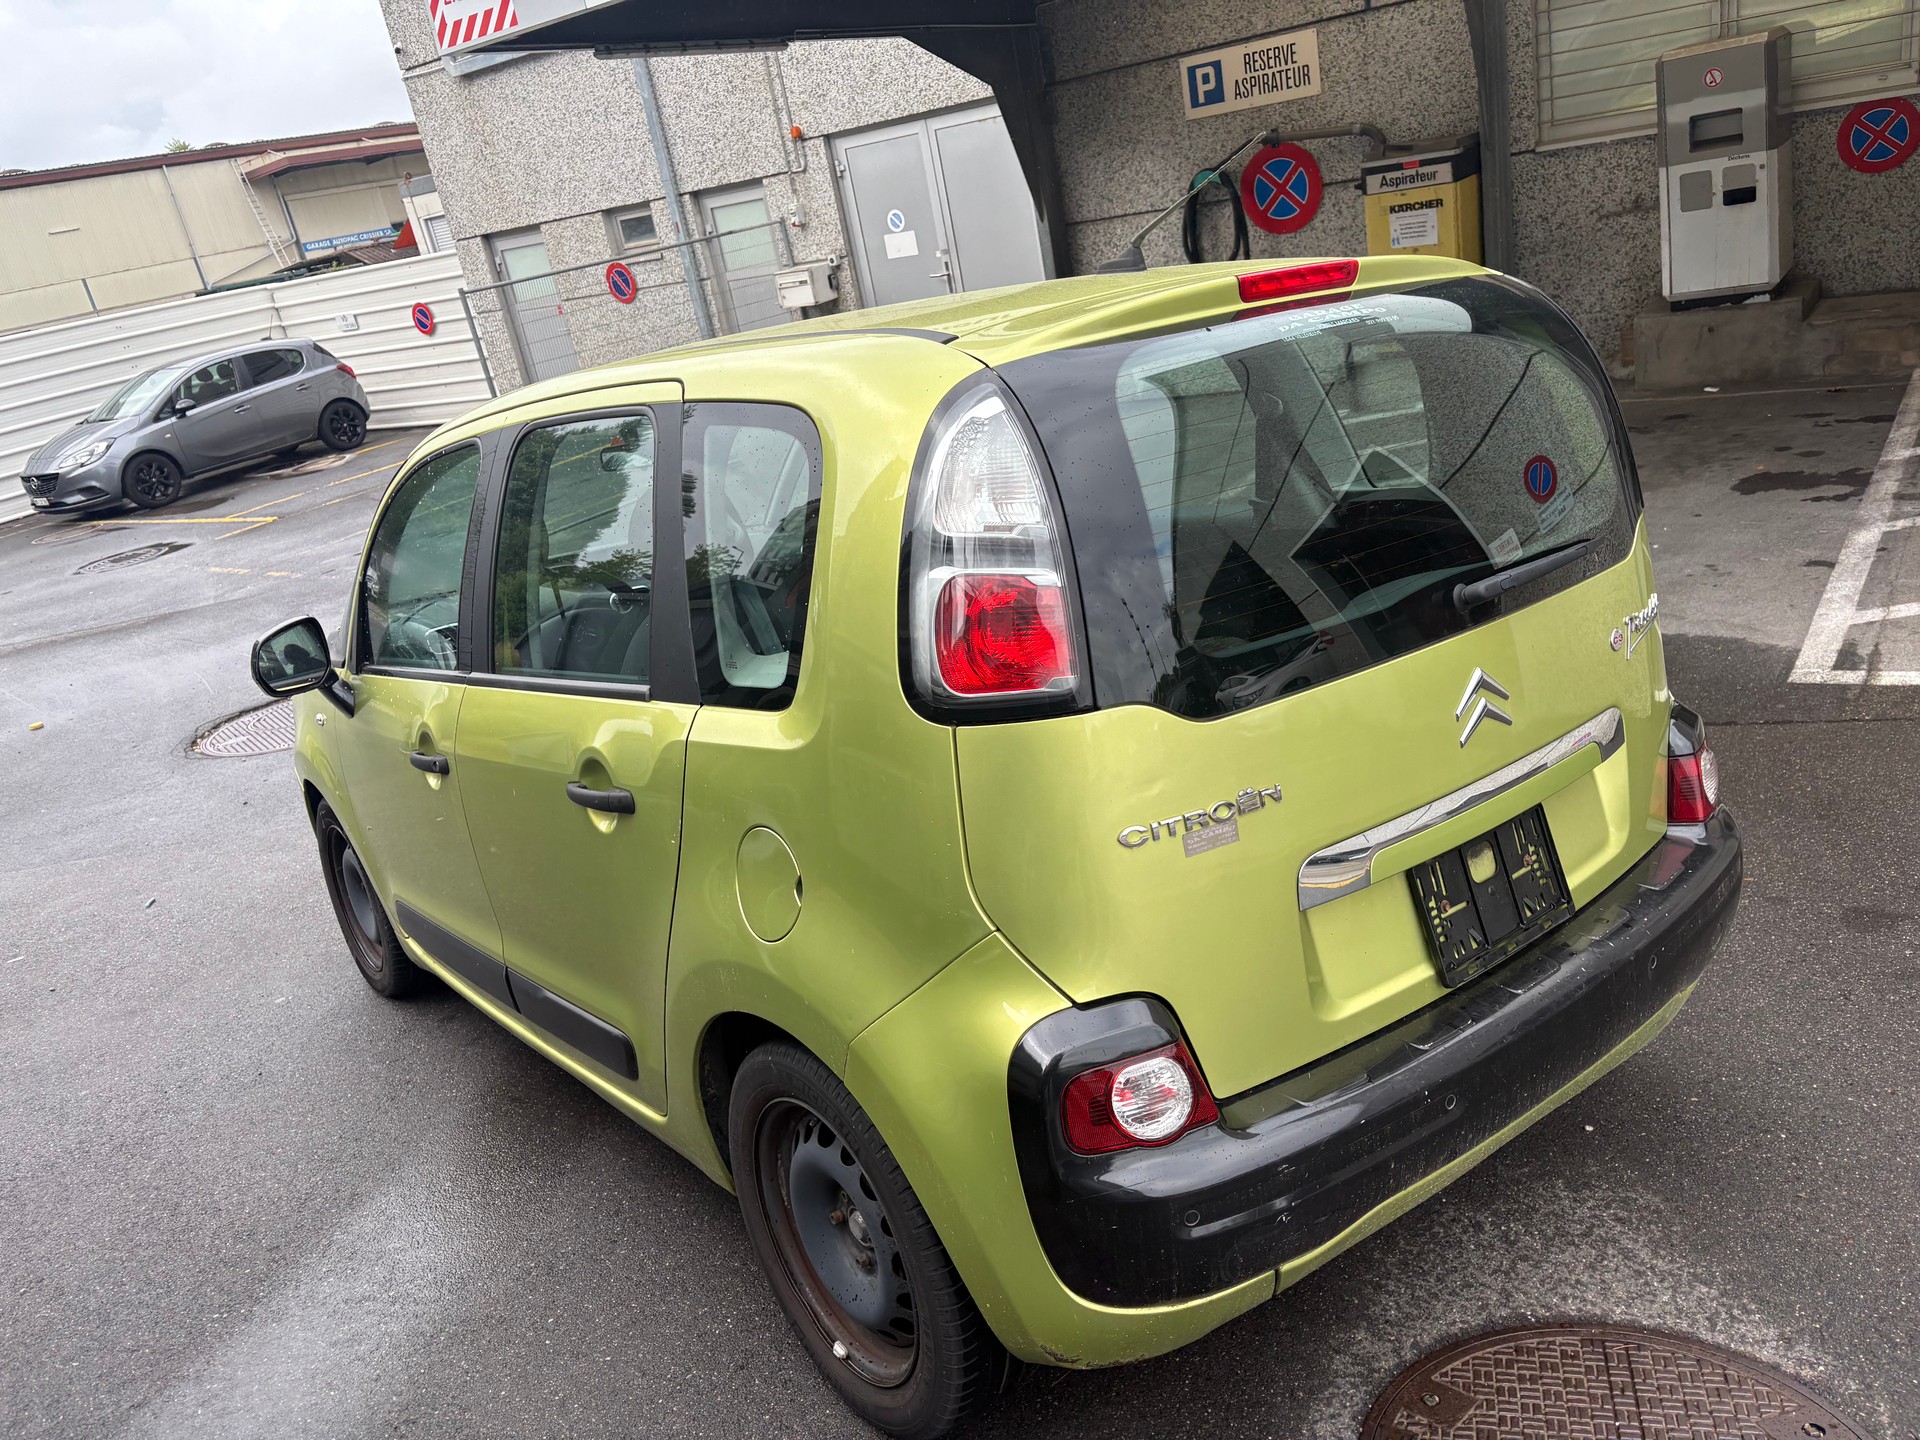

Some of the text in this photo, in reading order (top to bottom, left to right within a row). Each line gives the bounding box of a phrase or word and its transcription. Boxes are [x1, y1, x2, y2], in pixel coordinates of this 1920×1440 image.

[1243, 42, 1297, 74] RESERVE
[1234, 64, 1311, 100] ASPIRATEUR
[1380, 169, 1439, 189] Aspirateur
[306, 240, 331, 250] GARAGE
[1279, 307, 1387, 332] DA CAMPO
[1288, 303, 1364, 321] GARAGE
[1612, 633, 1624, 645] C3
[1117, 783, 1283, 848] CITROËN
